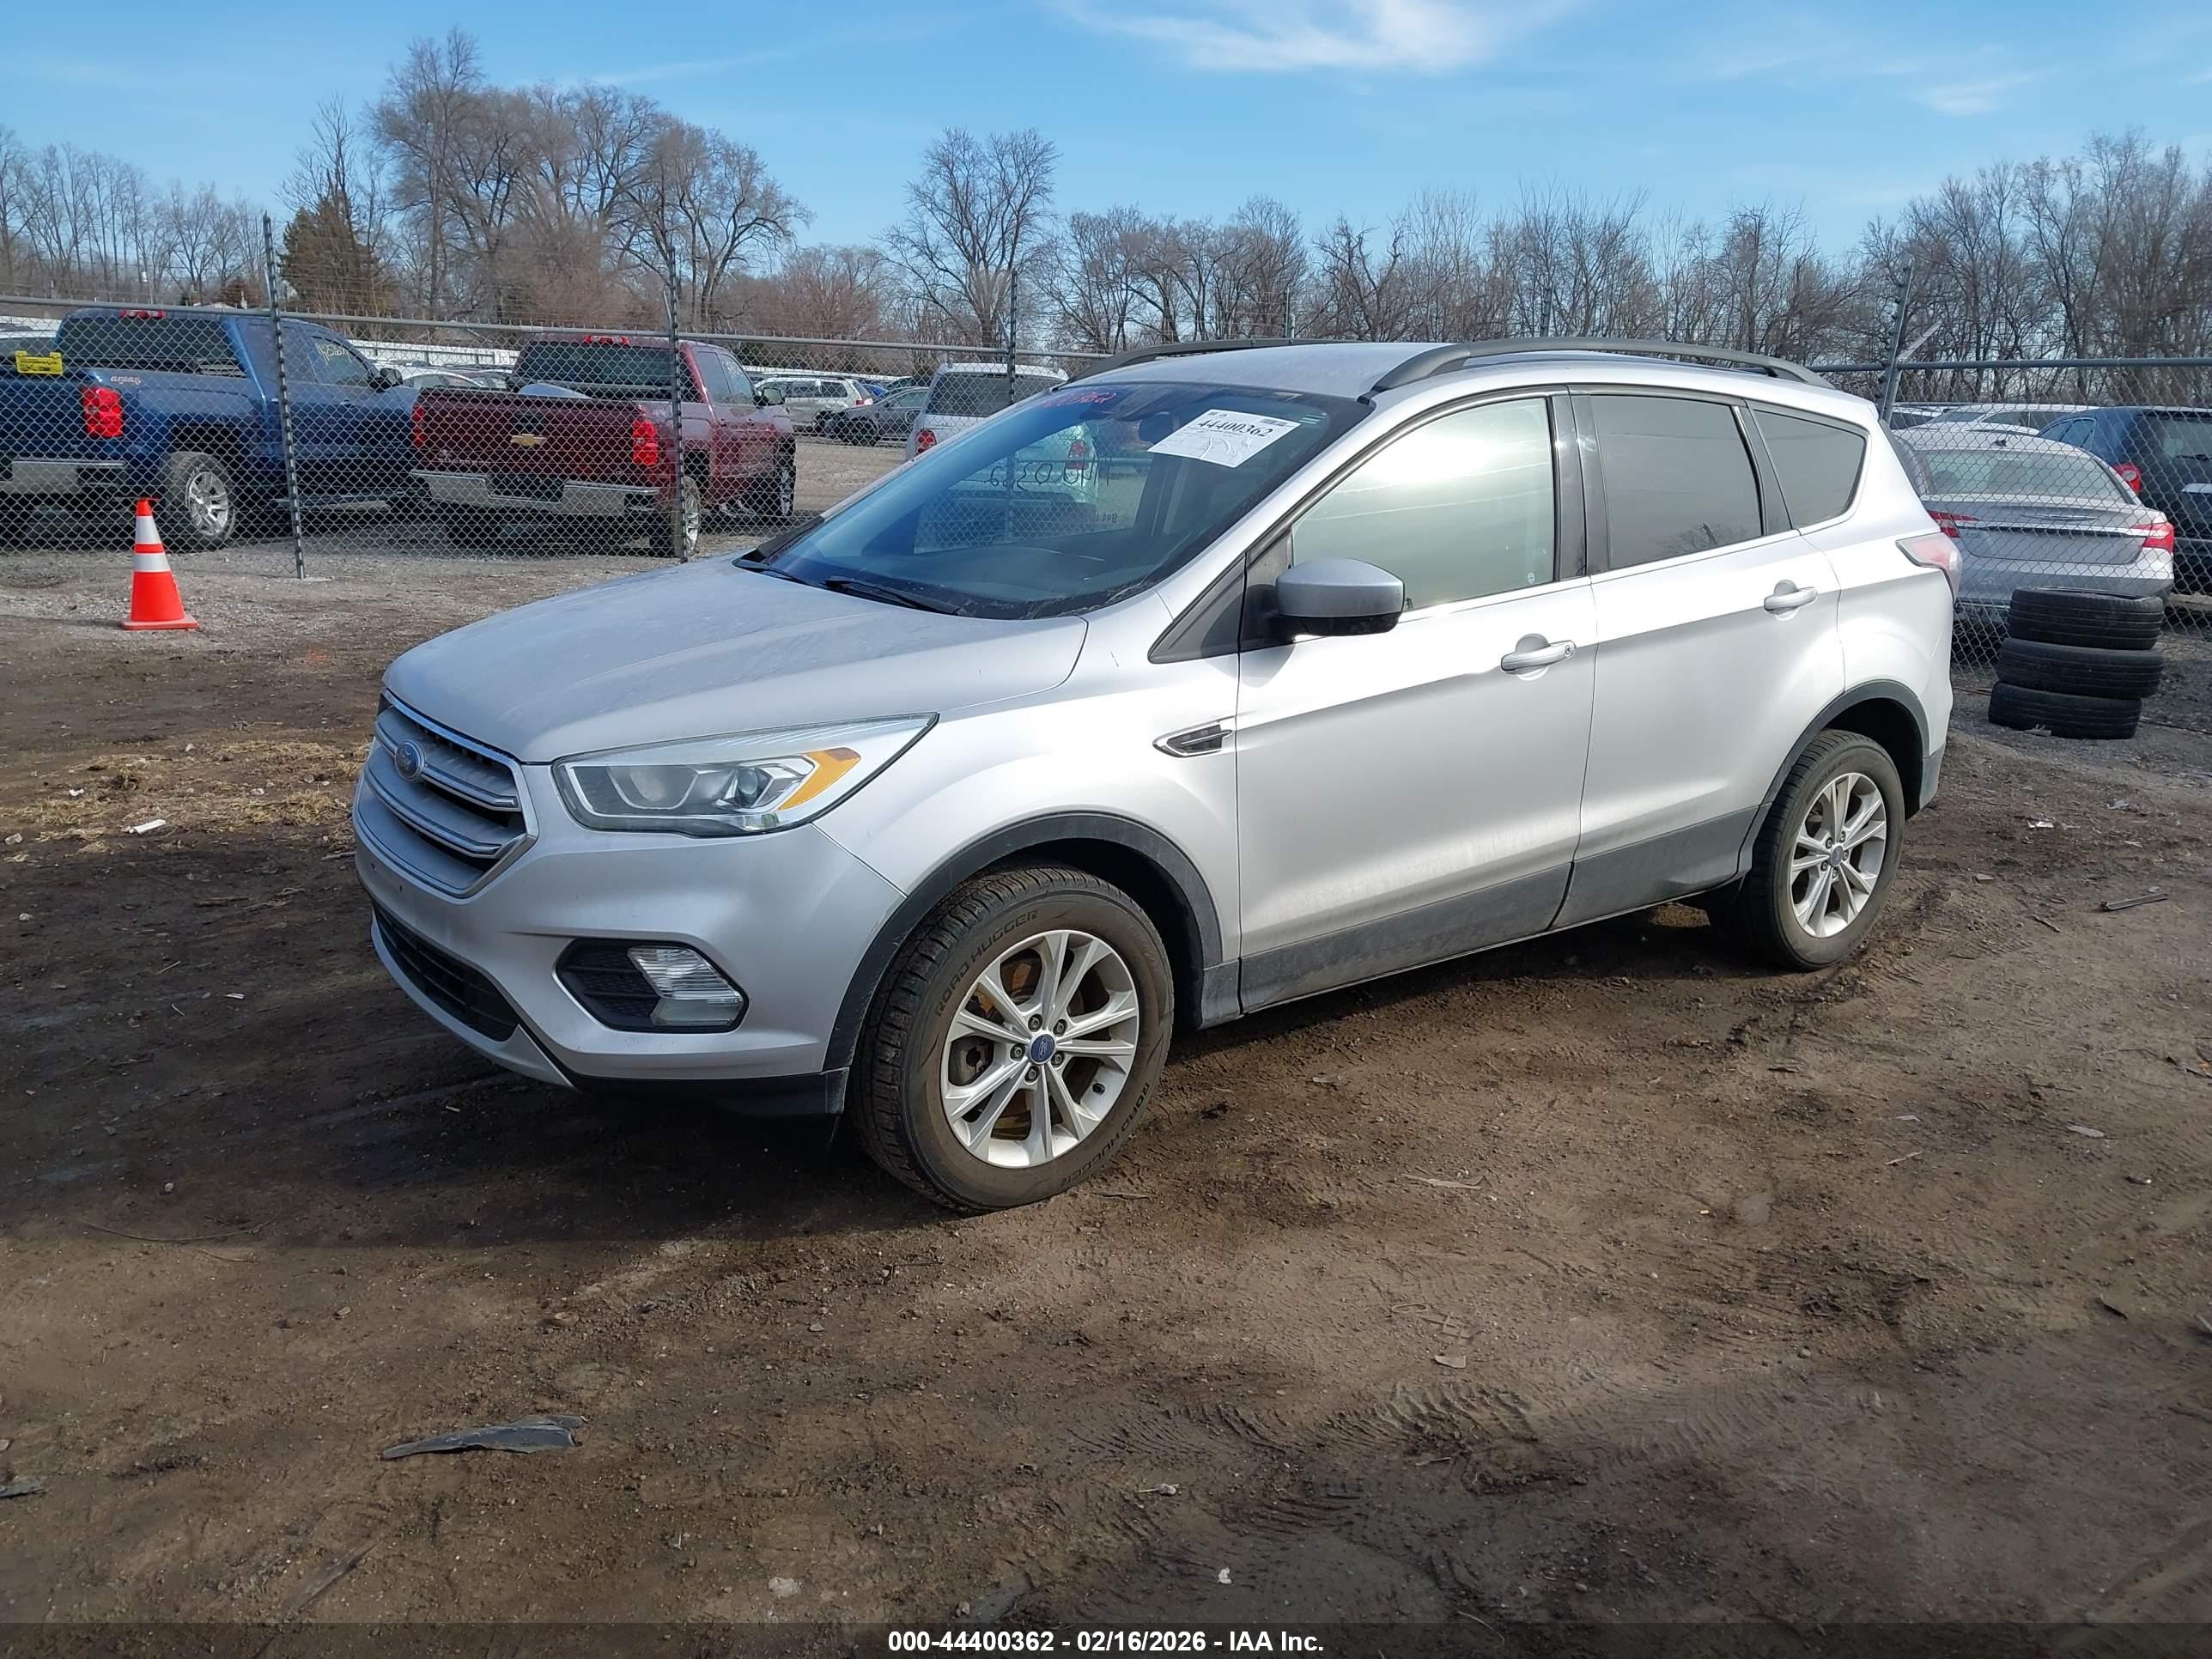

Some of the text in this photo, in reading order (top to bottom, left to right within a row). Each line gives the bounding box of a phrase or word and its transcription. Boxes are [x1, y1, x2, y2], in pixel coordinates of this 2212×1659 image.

[1198, 419, 1273, 437] 44400362
[935, 910, 1038, 1017] ROAD HUGGER
